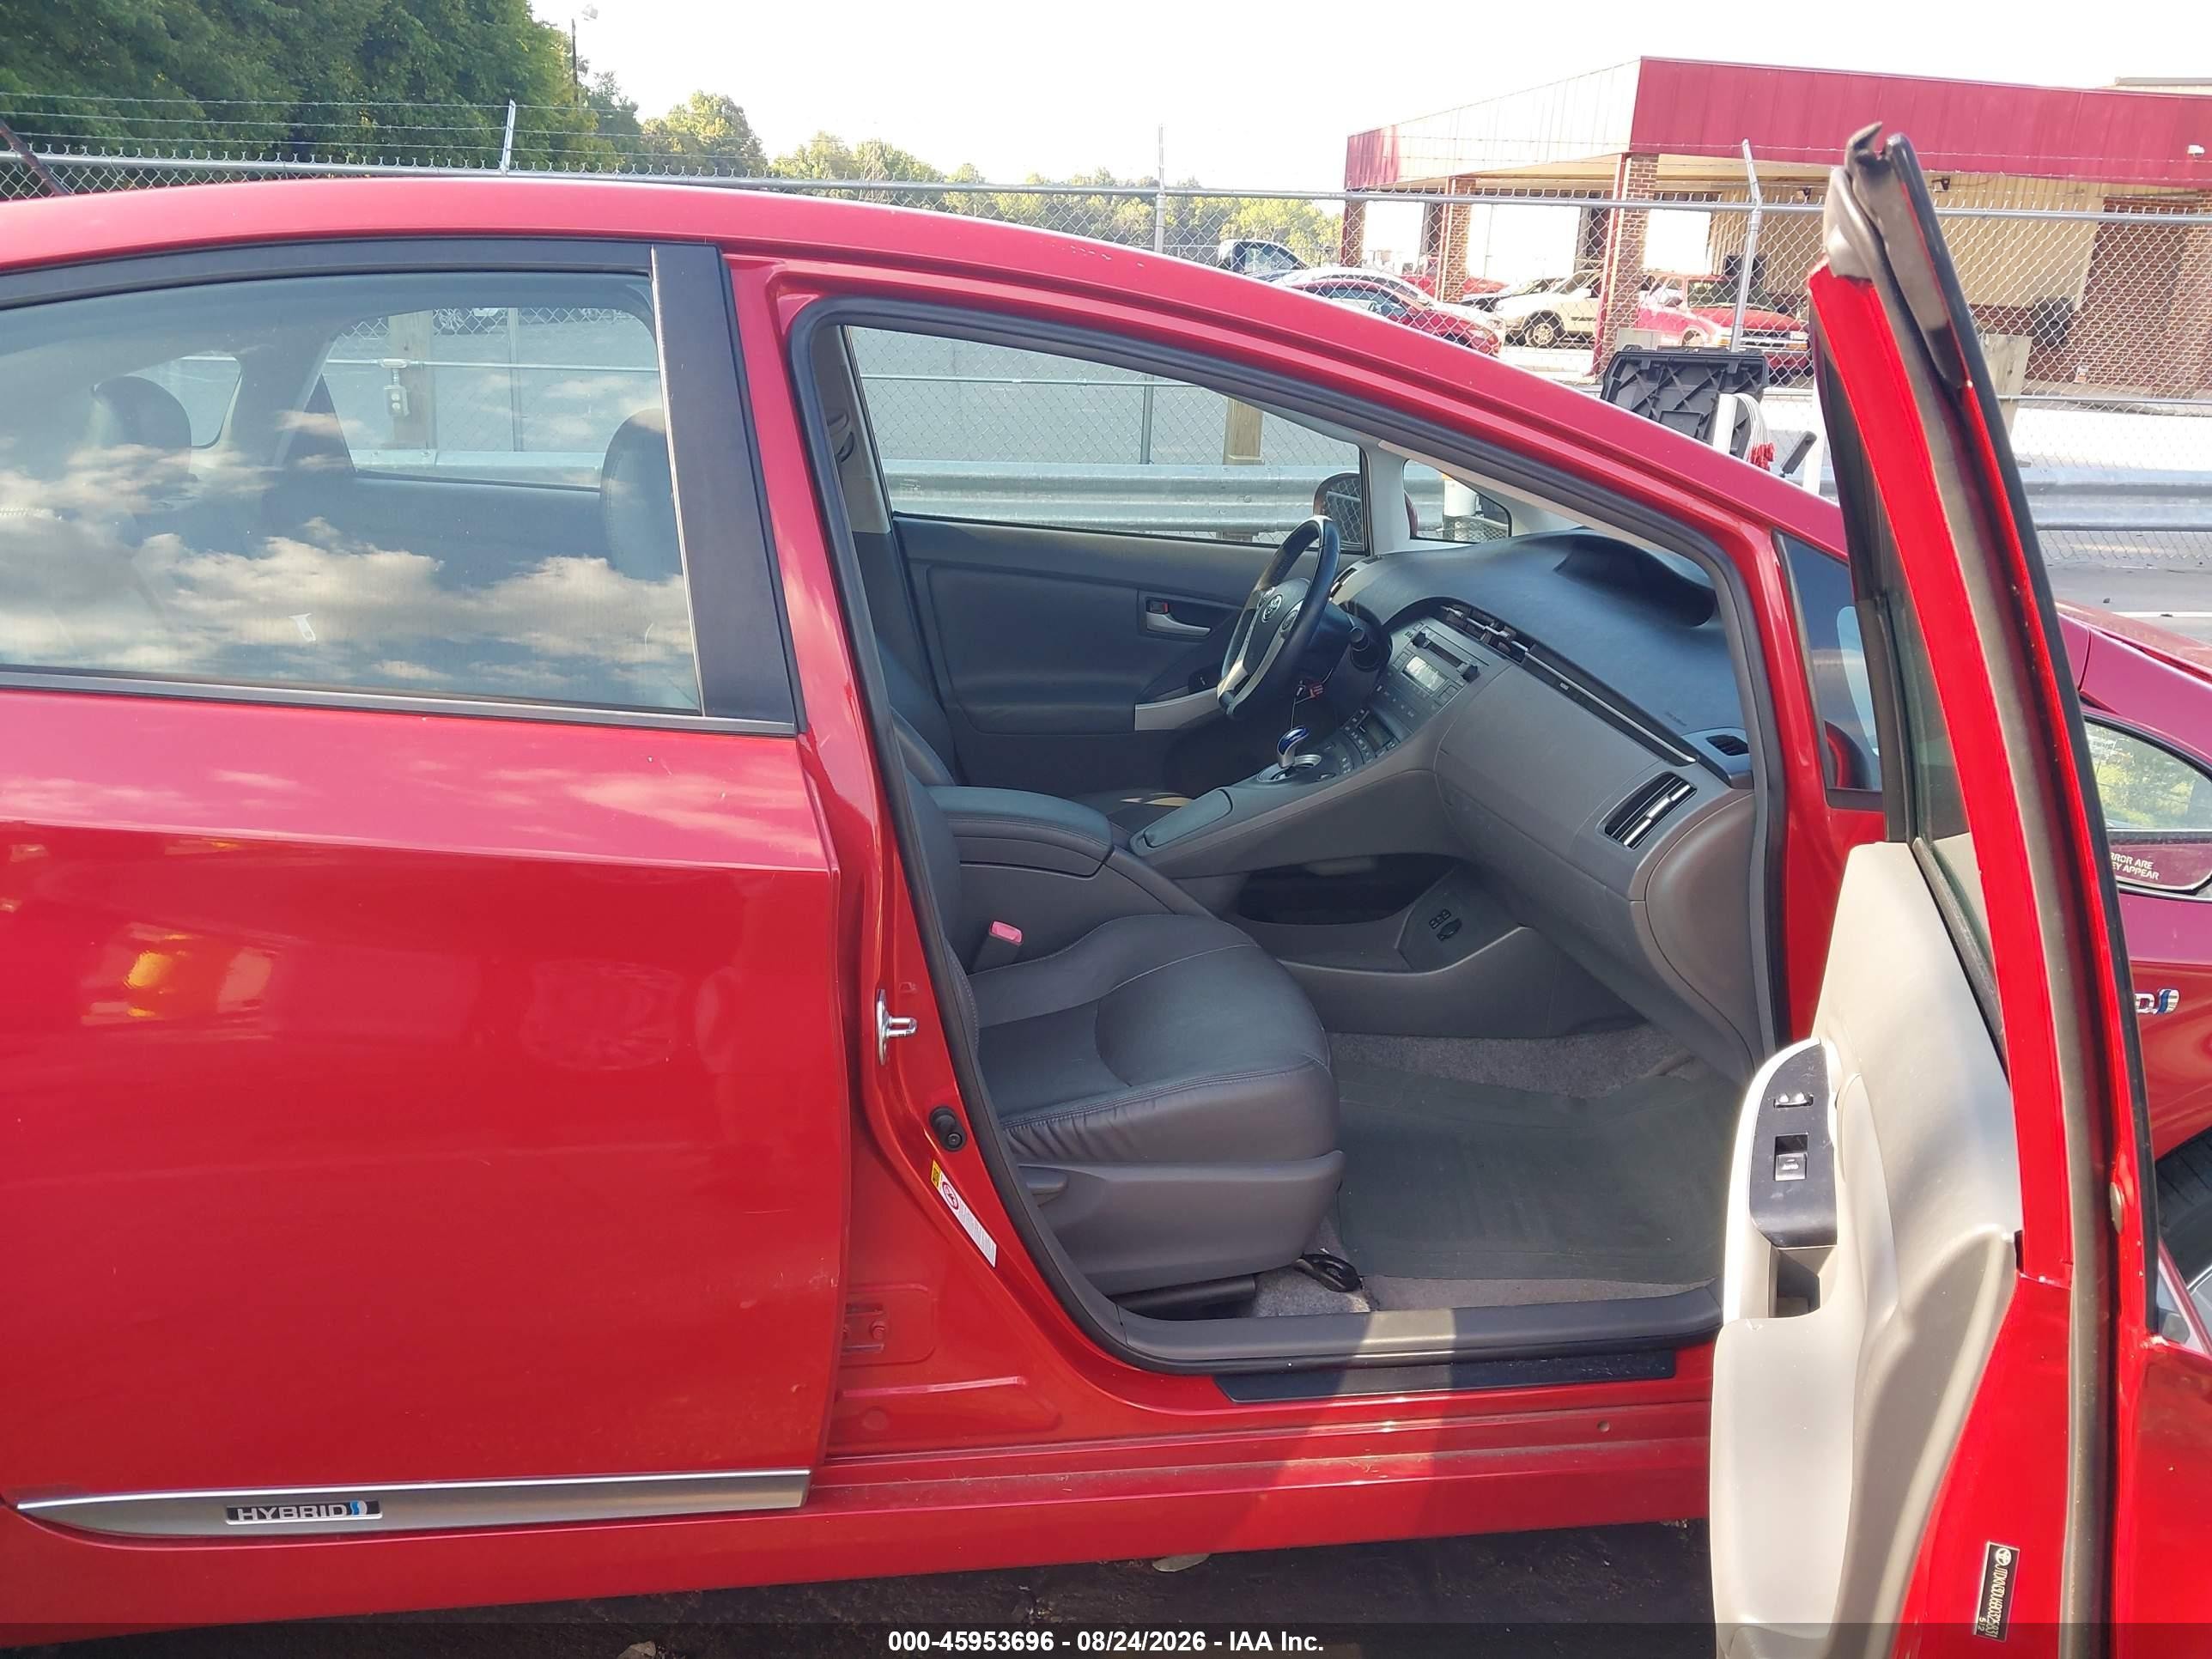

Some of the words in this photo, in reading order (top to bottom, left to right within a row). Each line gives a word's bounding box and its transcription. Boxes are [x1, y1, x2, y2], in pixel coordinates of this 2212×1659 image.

[2111, 852, 2133, 865] RROR
[2134, 859, 2154, 869] ARE
[2112, 861, 2122, 871] EY
[2123, 865, 2160, 880] APPEAR
[237, 1504, 347, 1521] HYBRID
